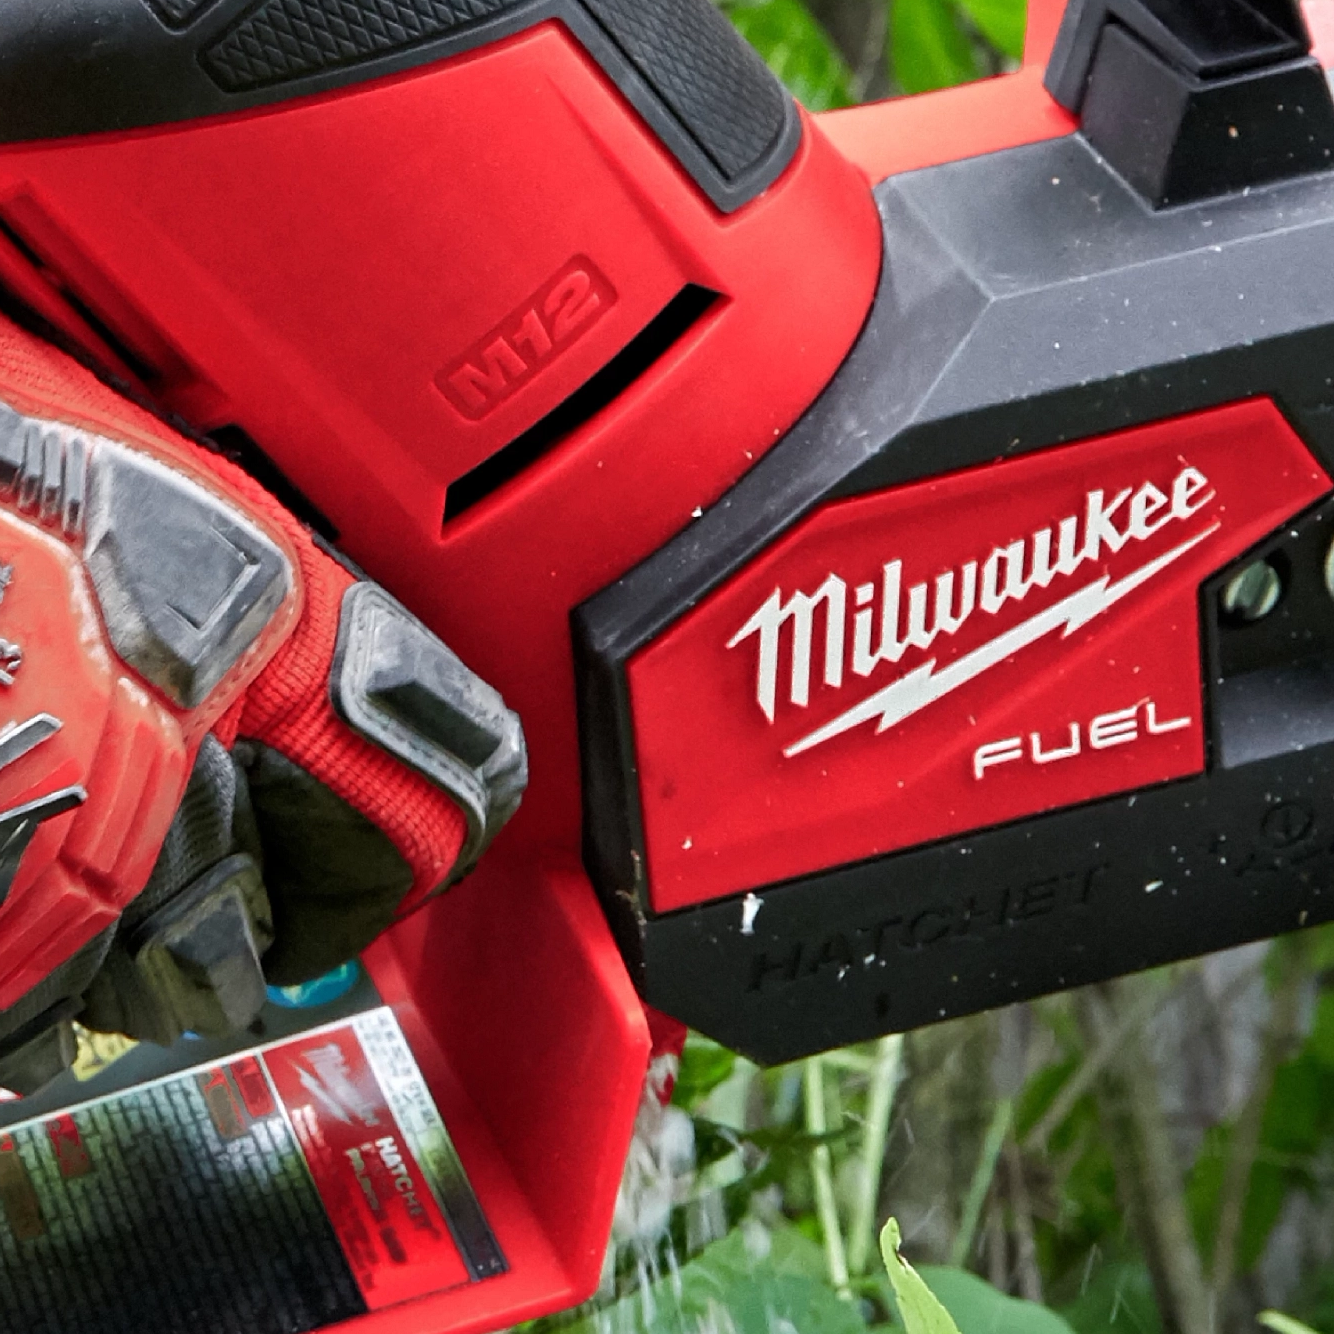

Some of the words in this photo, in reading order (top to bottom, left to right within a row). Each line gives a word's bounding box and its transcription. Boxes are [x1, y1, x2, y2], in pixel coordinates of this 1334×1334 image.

[447, 270, 600, 405] M12
[726, 466, 1212, 724] Milwaukee
[973, 700, 1192, 780] FUEL
[745, 861, 1113, 993] HATCHET
